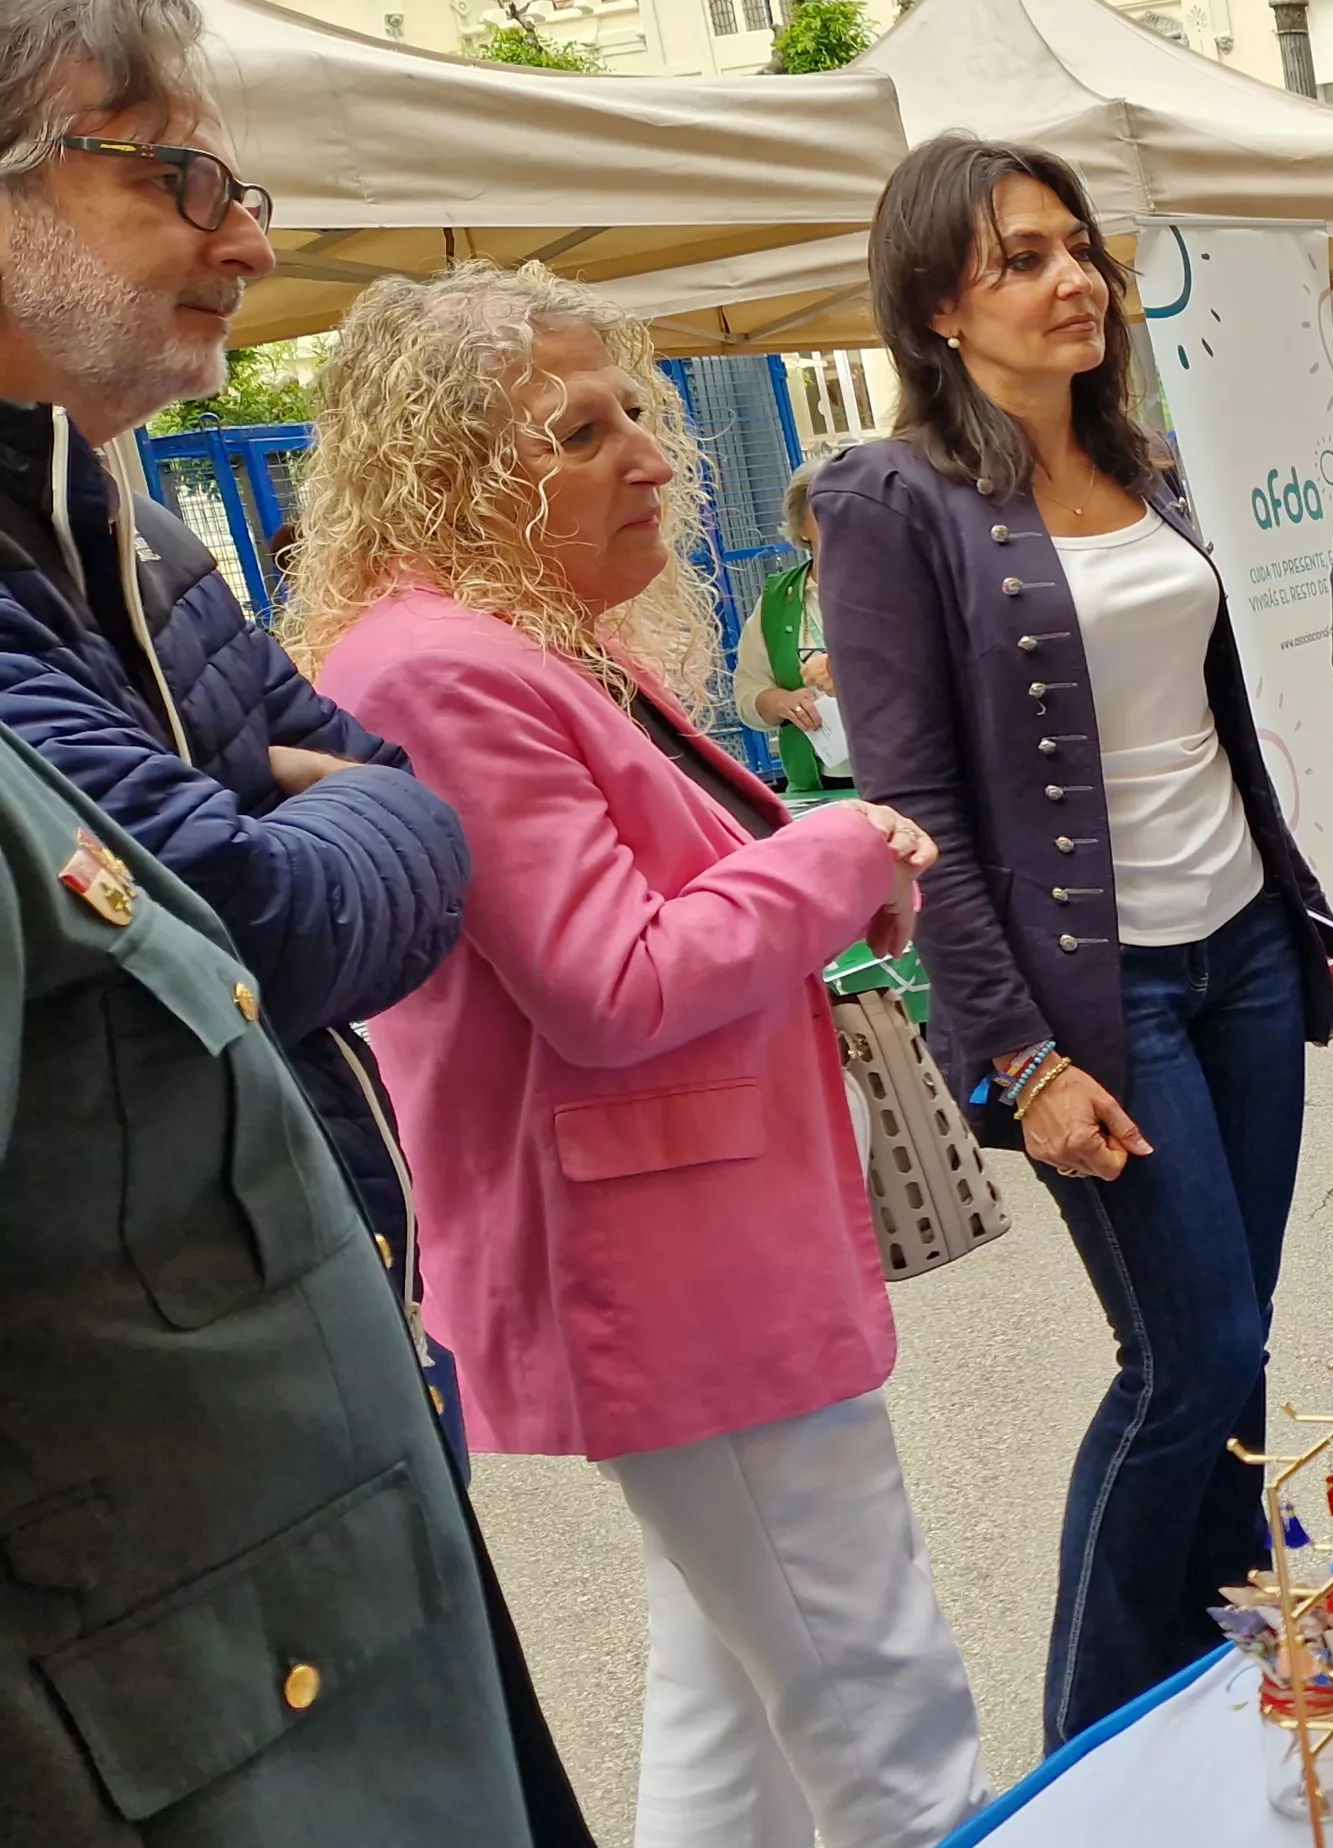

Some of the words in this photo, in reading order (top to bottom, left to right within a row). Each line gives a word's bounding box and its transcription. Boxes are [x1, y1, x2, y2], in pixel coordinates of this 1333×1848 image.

[1251, 466, 1324, 531] afda
[1249, 565, 1272, 584] CUIDA
[1271, 561, 1282, 578] TU
[1282, 552, 1328, 576] PRESENTE,
[1279, 588, 1290, 605] EL
[1289, 581, 1317, 602] RESTO
[1317, 578, 1329, 595] DE
